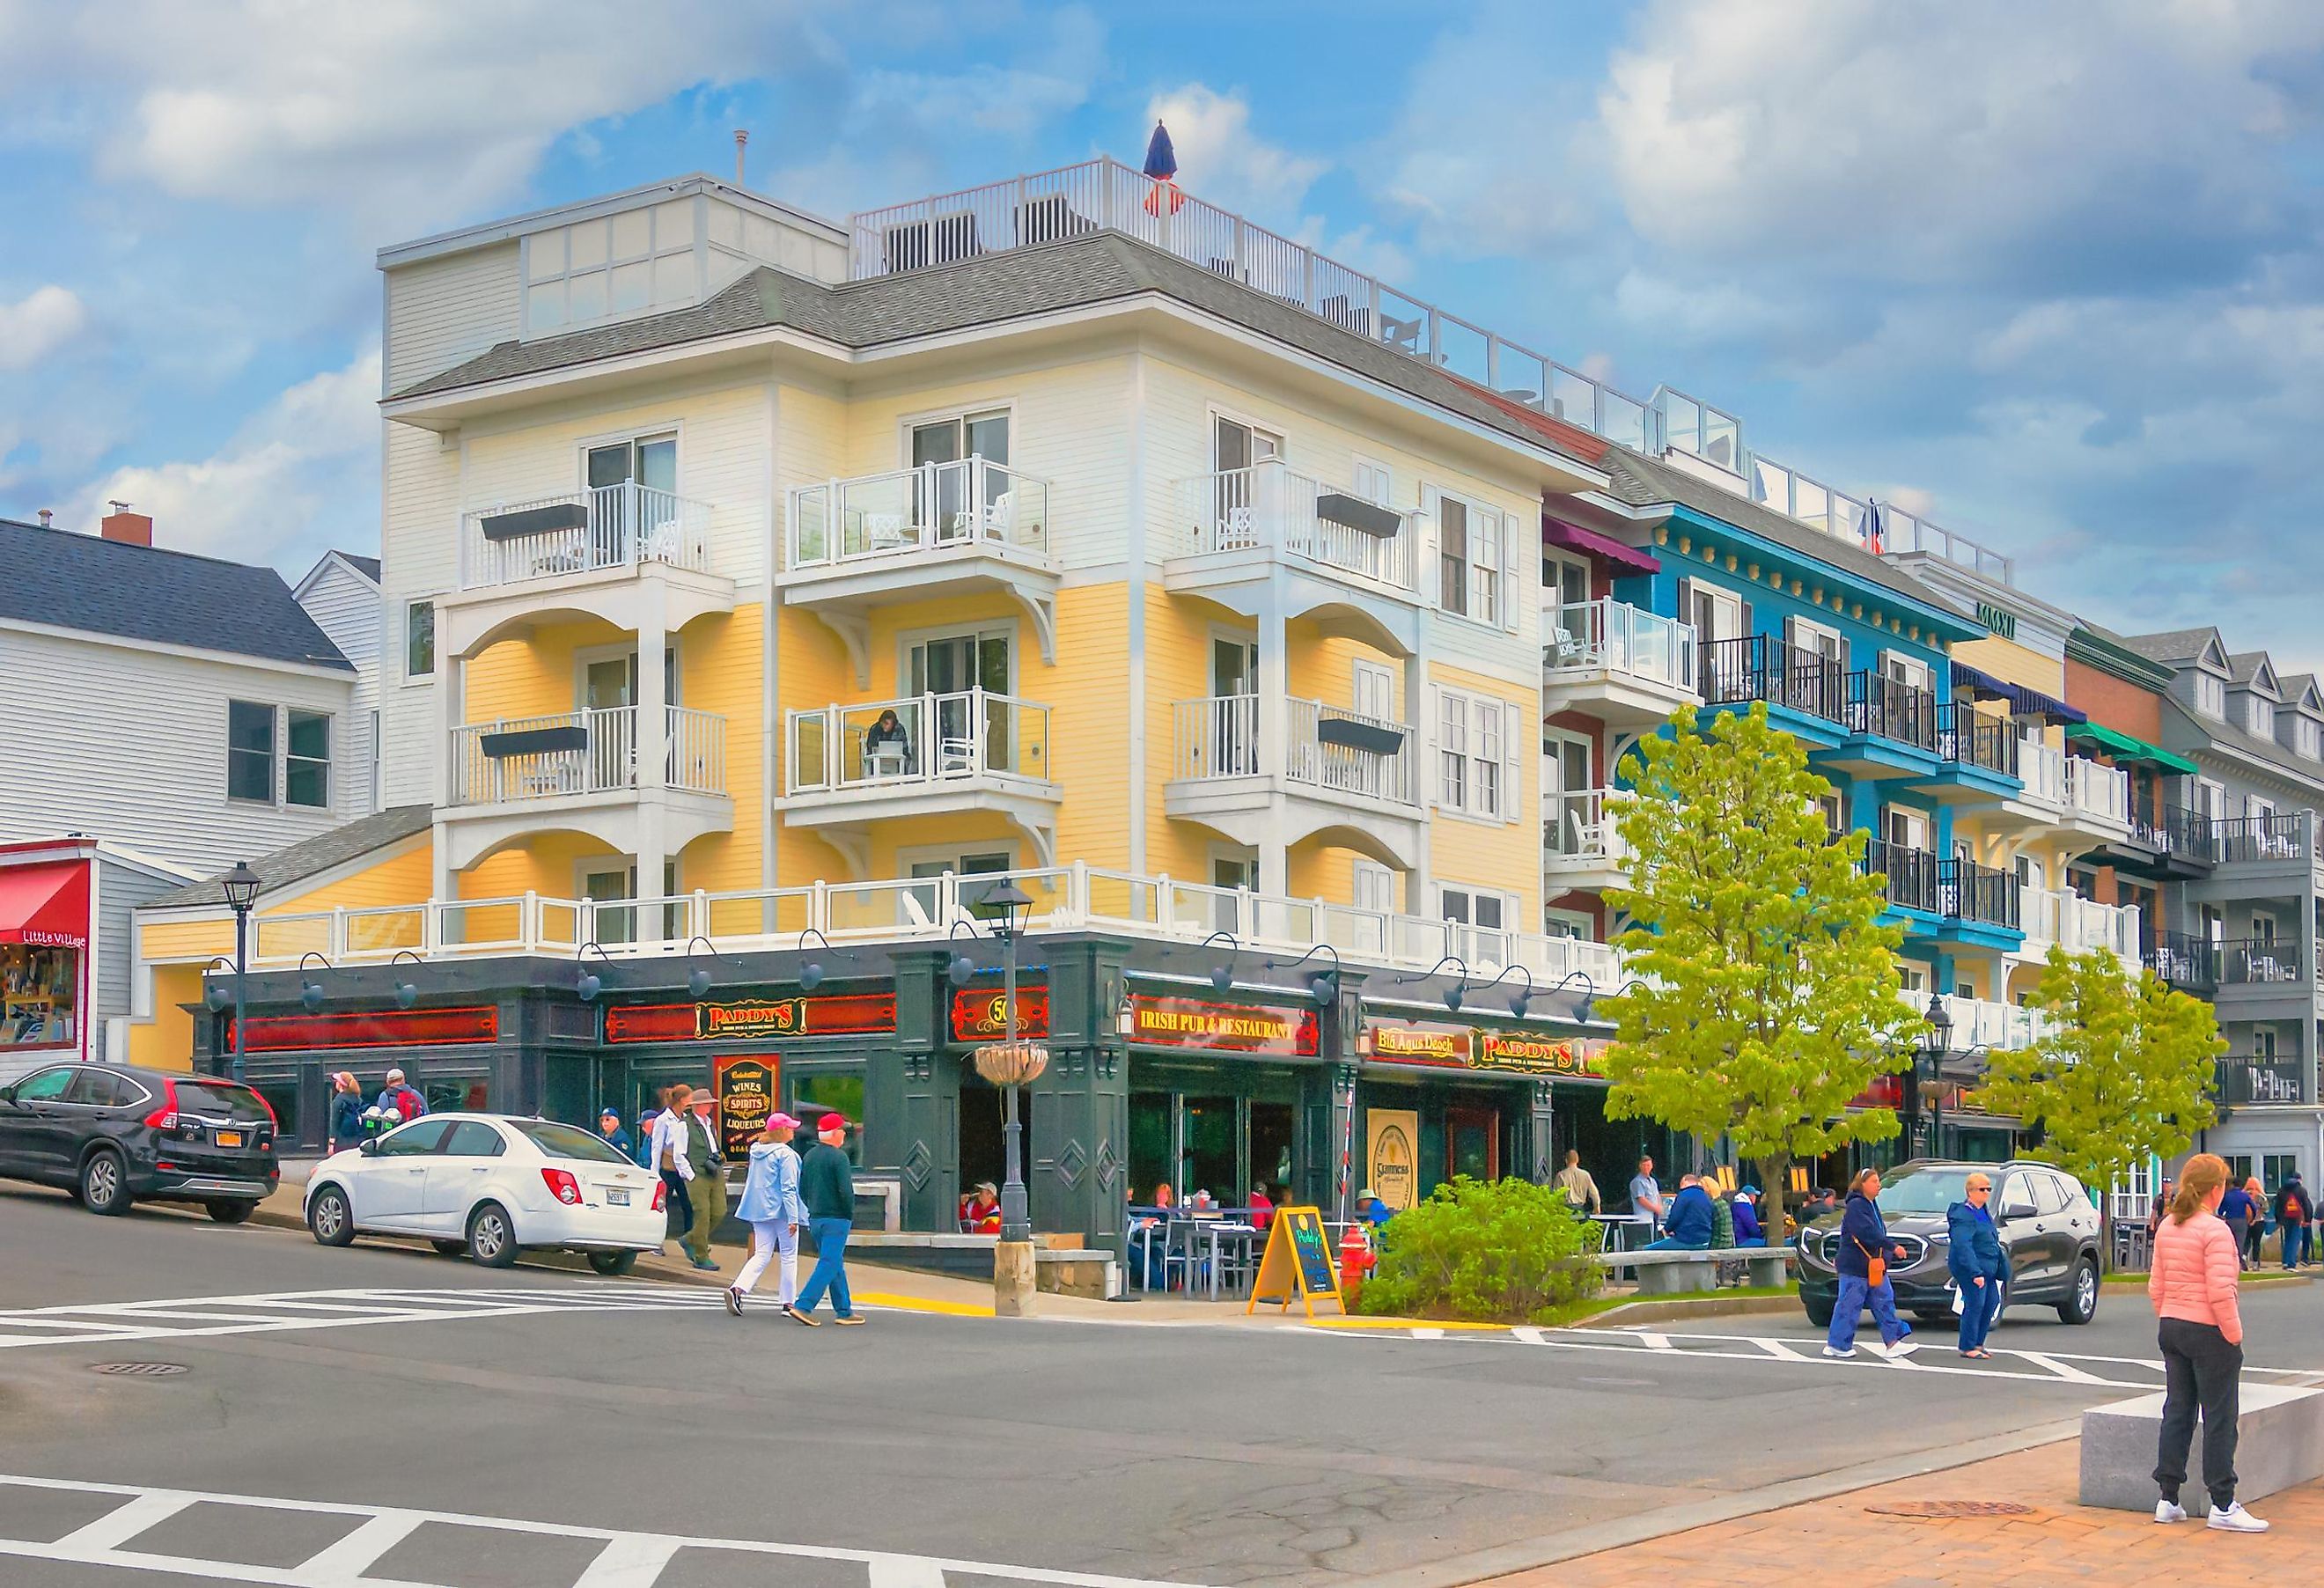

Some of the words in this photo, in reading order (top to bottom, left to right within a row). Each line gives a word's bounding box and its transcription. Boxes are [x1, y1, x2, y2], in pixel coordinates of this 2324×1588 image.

[1976, 602, 2015, 638] MMXII
[709, 1004, 793, 1031] PADDY'S
[1140, 1011, 1178, 1030] IRISH
[1180, 1014, 1205, 1033] PUB
[1207, 1017, 1217, 1034] &
[1218, 1018, 1293, 1040] RESTAURANT
[1482, 1035, 1573, 1069] PADDY'S
[732, 1082, 761, 1093] WINES
[731, 1099, 763, 1109] SPIRITS
[726, 1118, 766, 1130] LIQUEURS
